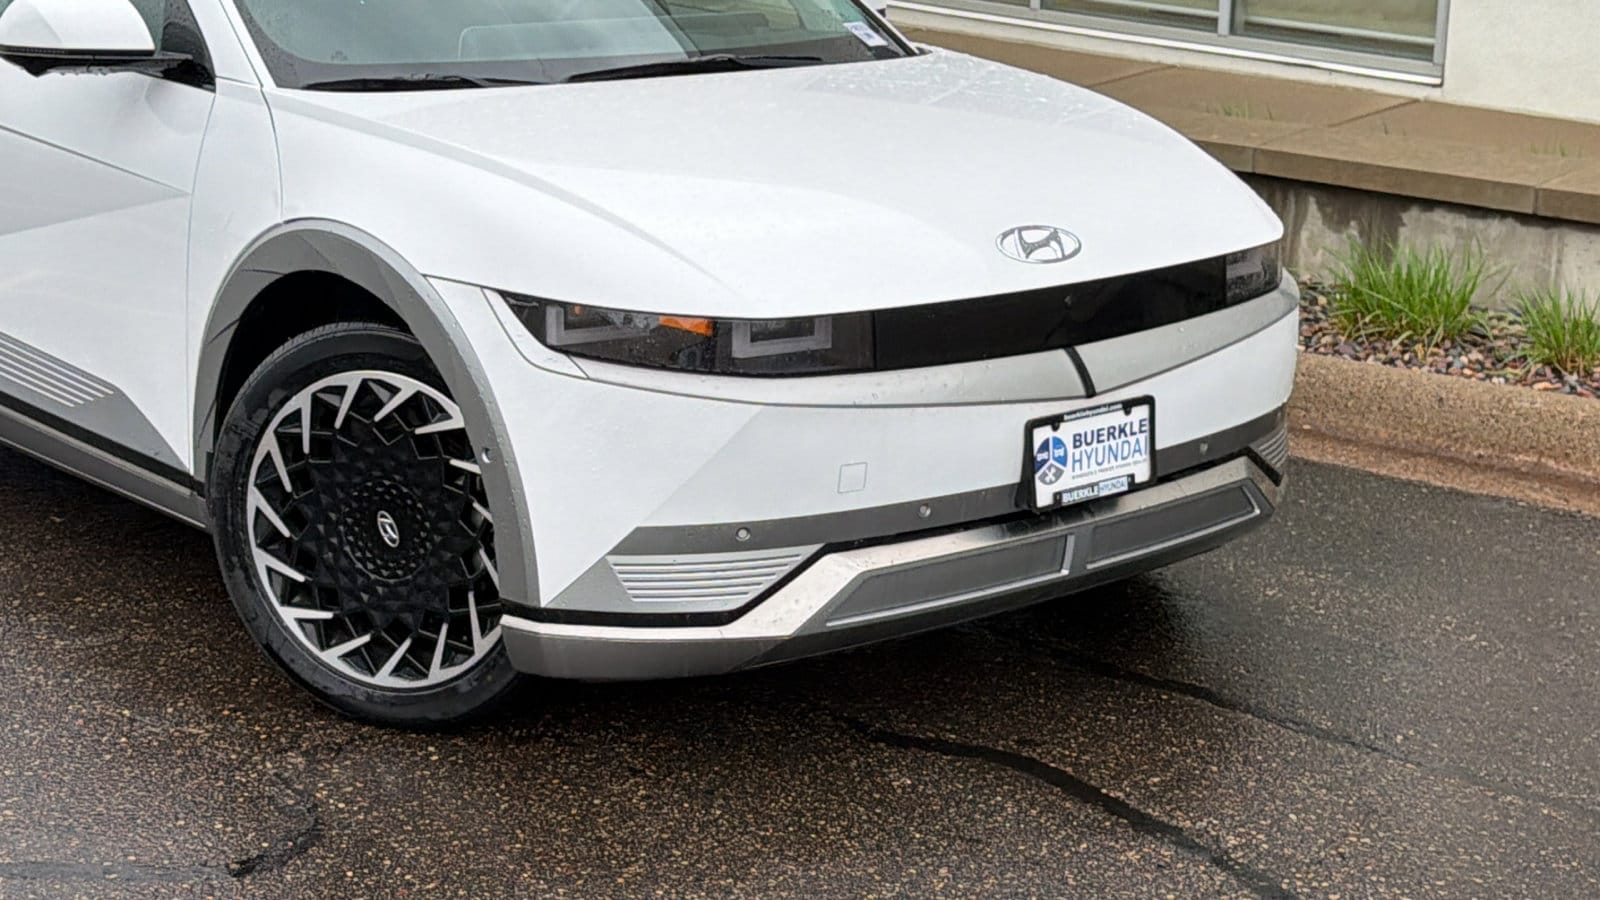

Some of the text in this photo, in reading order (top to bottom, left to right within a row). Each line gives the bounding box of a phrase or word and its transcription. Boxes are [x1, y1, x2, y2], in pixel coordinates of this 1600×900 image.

[1073, 418, 1148, 450] BUERKLE
[1072, 435, 1148, 473] HYUNDAI
[1062, 485, 1099, 503] BUERKLE
